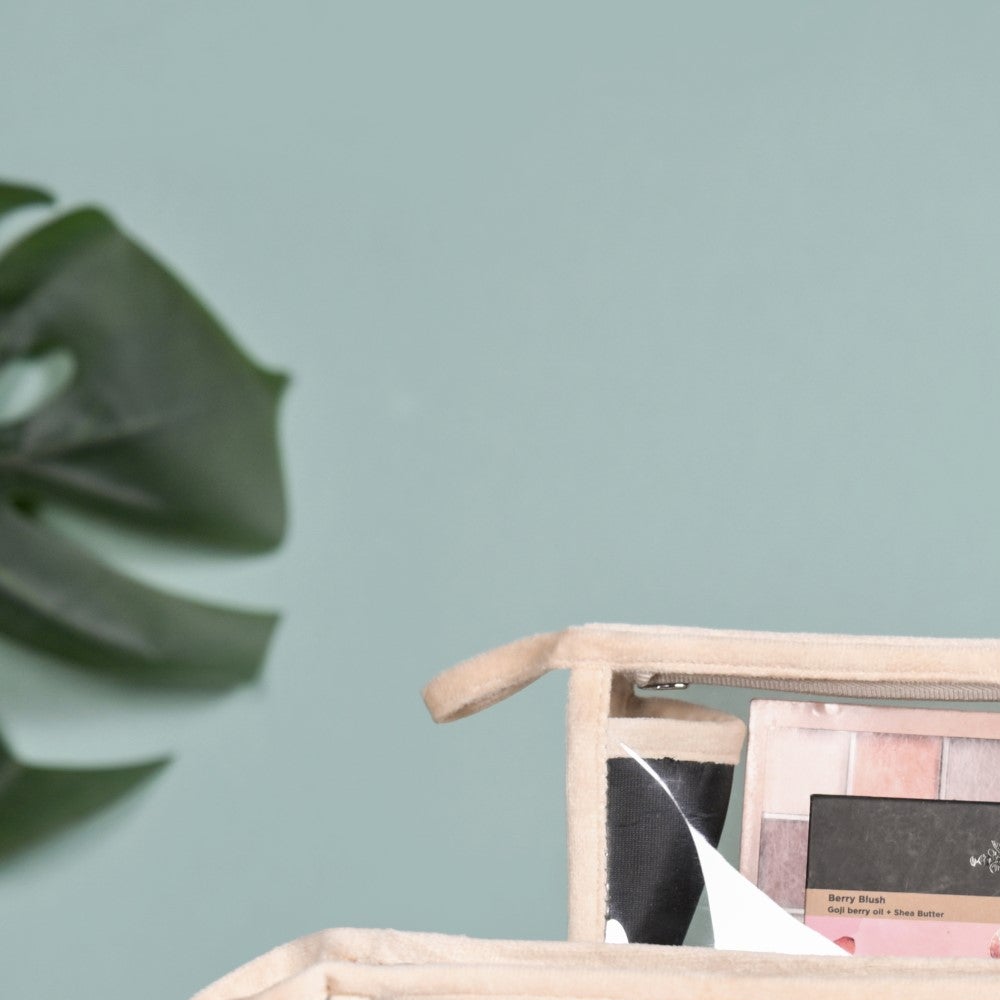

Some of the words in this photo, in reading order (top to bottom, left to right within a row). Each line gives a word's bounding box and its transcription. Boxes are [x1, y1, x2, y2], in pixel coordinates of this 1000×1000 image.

[828, 894, 855, 904] Berry
[858, 895, 886, 904] Blush
[828, 906, 844, 914] Goji
[848, 907, 870, 916] berry
[894, 909, 914, 917] Shea
[917, 910, 944, 918] Butter
